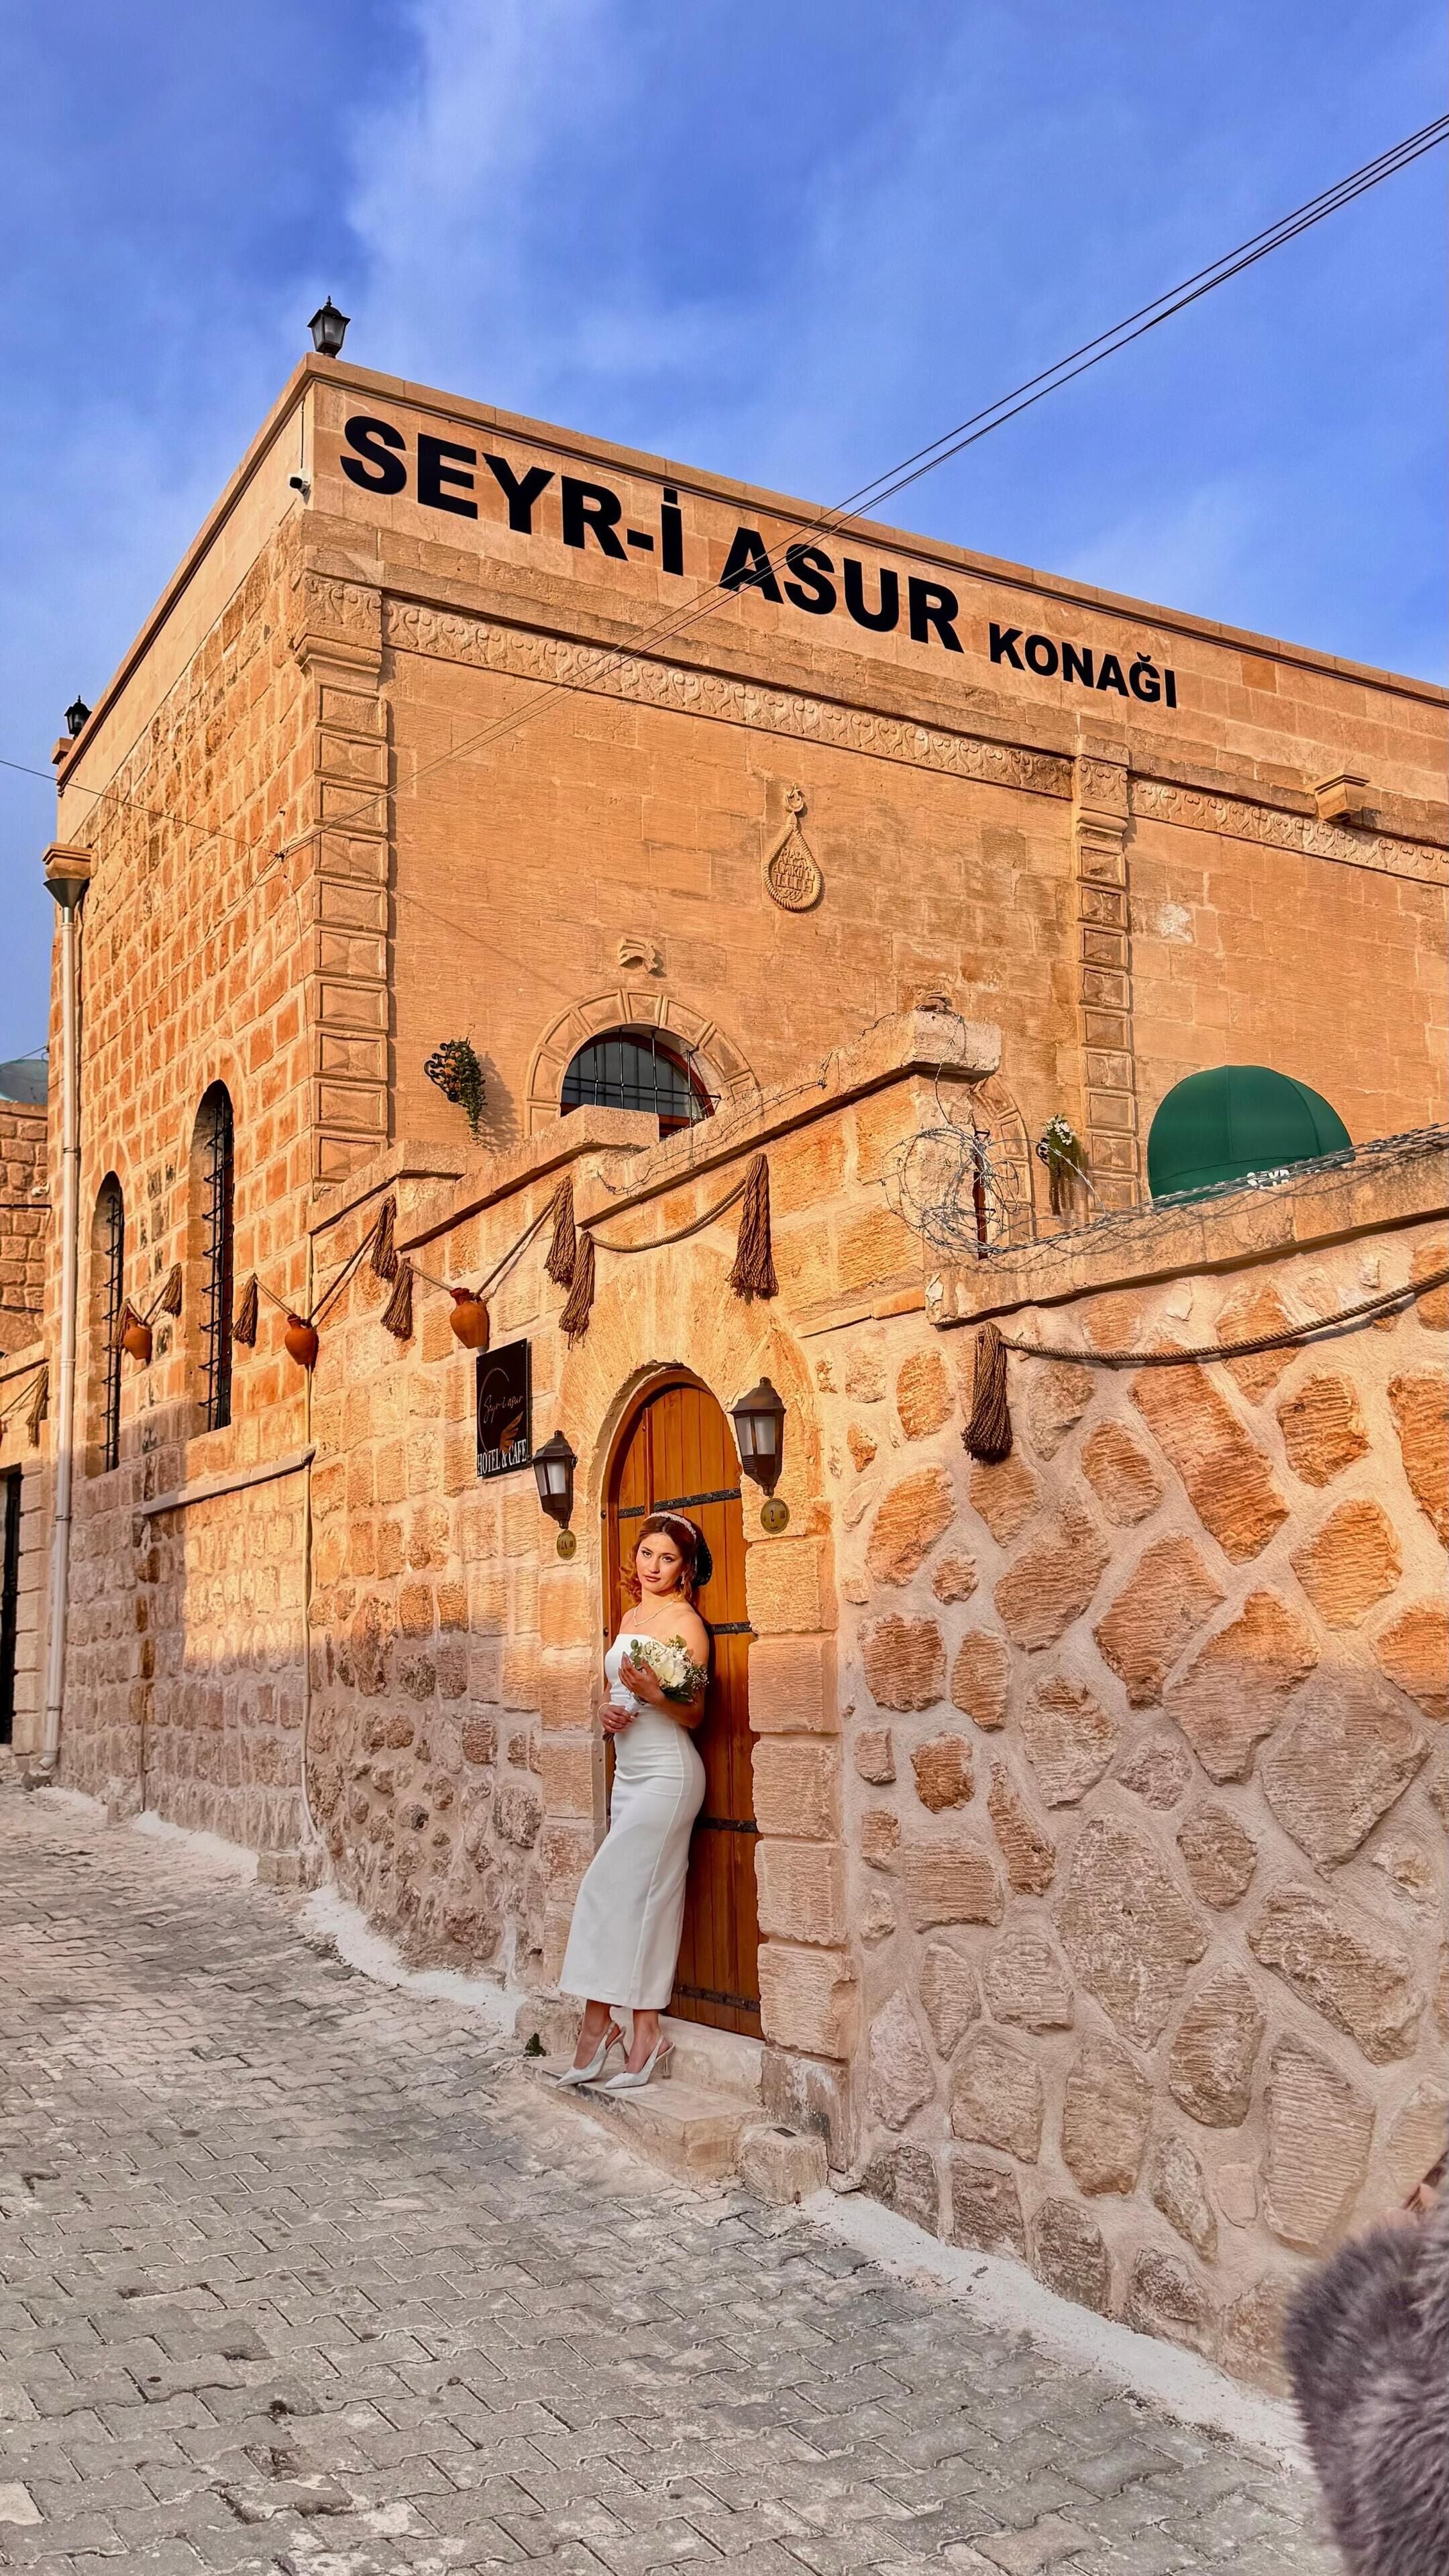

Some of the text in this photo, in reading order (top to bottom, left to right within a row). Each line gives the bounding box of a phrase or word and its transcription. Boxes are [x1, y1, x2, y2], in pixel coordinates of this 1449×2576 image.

[340, 415, 1177, 709] SEYR-İ ASUR KONAĞI
[477, 1438, 527, 1475] HOTEL & CAFE
